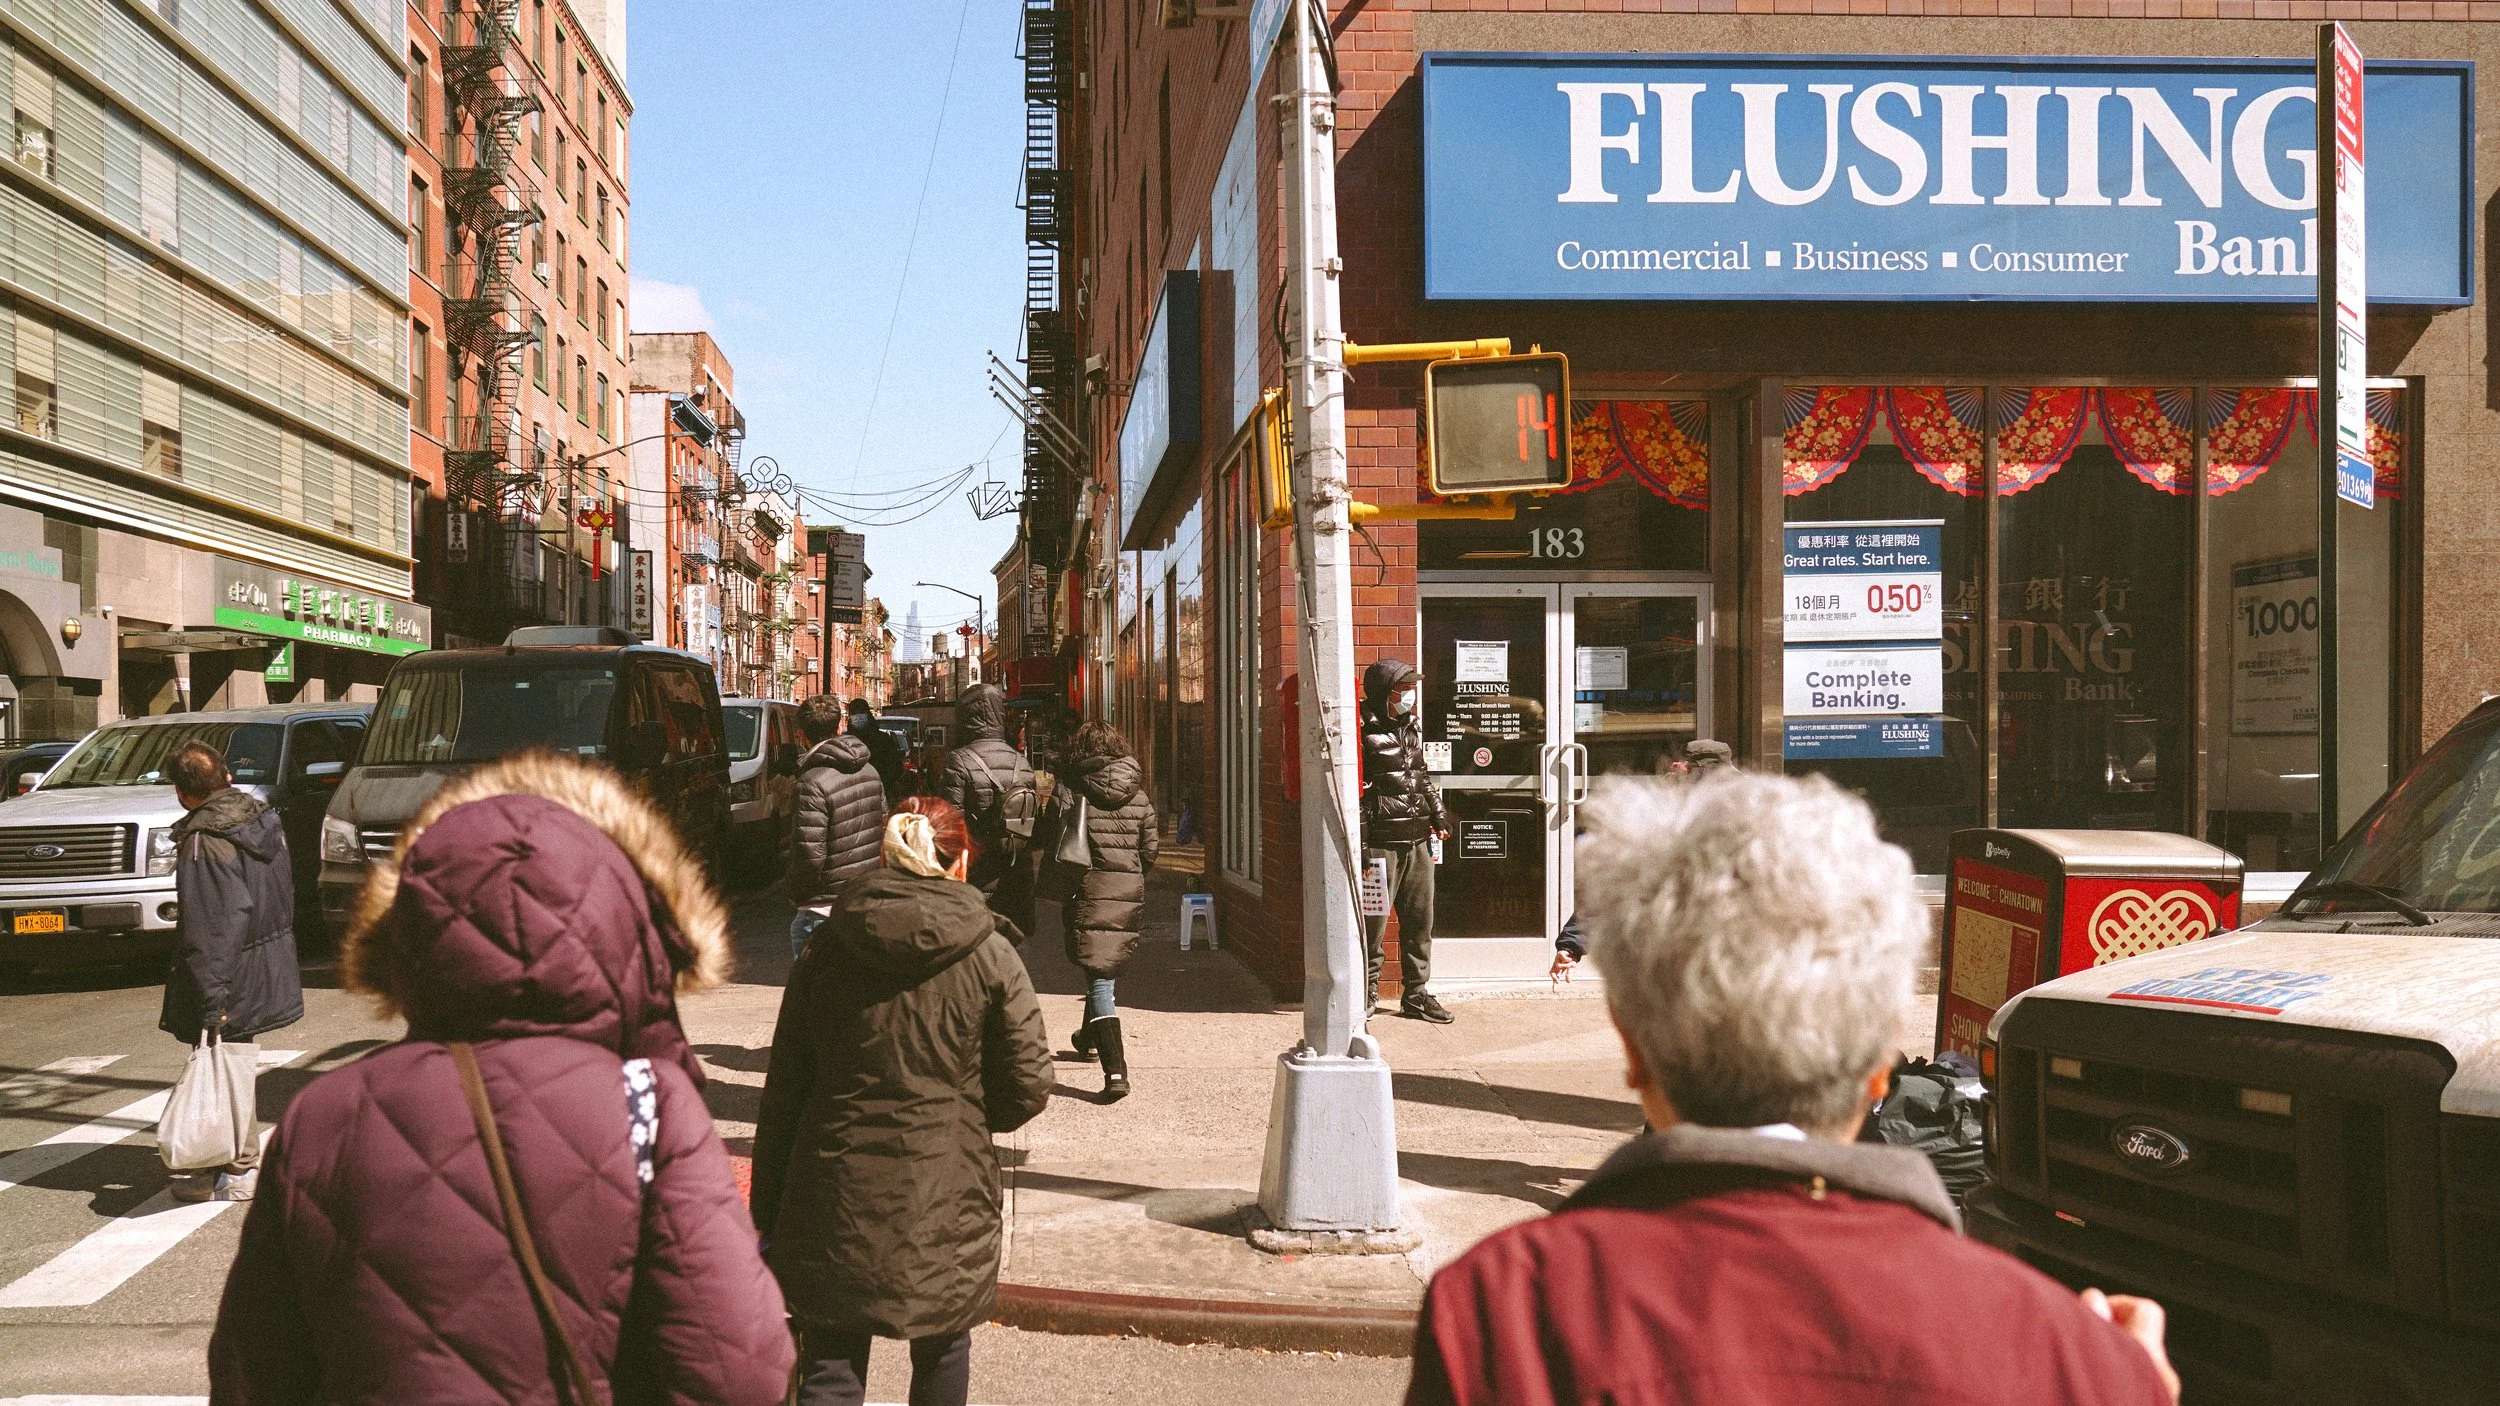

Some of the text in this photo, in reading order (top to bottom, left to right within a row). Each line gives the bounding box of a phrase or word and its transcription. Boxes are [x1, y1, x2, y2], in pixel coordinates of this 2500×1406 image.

[1556, 82, 2317, 211] FLUSHING
[1556, 240, 2129, 274] Commercial Business Consumer
[1516, 392, 1557, 462] 14
[1528, 528, 1585, 559] 183
[1798, 534, 1920, 548] 優惠利率 從這裡開始
[1784, 552, 1931, 567] Great rates. Start here.
[1795, 595, 1840, 610] 18個月
[1867, 584, 1932, 613] 0.50%
[303, 625, 372, 648] PHARMACY
[1942, 622, 2136, 674] SHING
[1457, 683, 1510, 693] FLUSHING
[1806, 670, 1911, 690] Complete
[2064, 676, 2134, 701] Bank
[1812, 690, 1906, 710] Banking.
[1882, 730, 1930, 739] FLUSHING
[1986, 841, 2011, 859] Bigbelly
[1957, 876, 1991, 901] WELCOME
[1999, 888, 2043, 915] CHINATOWN
[1952, 1013, 1982, 1042] SHOW
[2127, 1132, 2165, 1161] Ford
